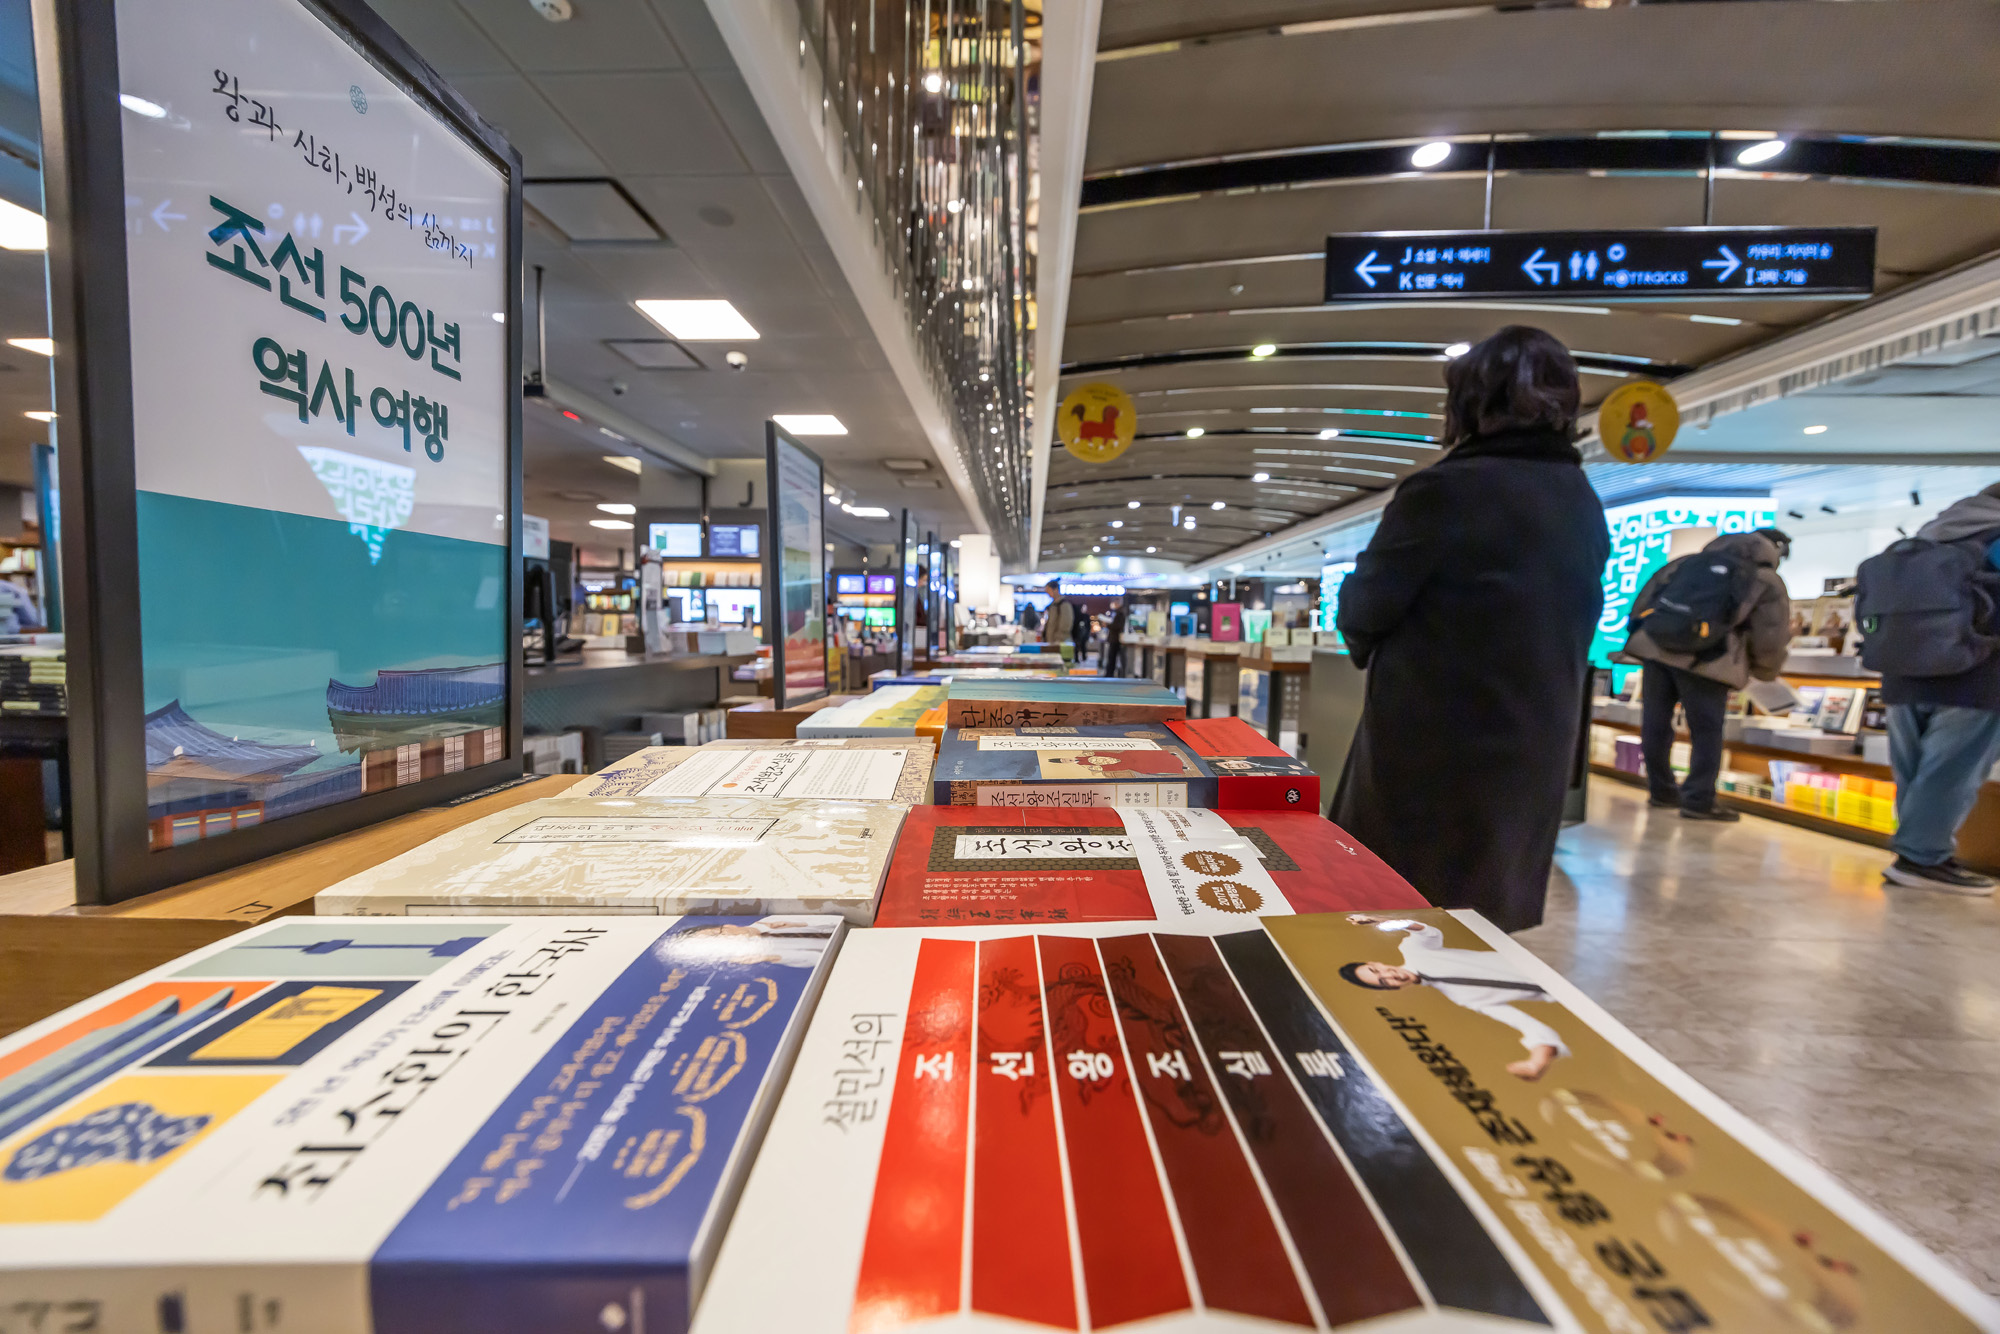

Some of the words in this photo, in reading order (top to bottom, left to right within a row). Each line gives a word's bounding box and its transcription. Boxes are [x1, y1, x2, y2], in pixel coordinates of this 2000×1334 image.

[212, 69, 283, 141] 왕과
[421, 213, 474, 269] 삶까지
[1400, 246, 1413, 265] J
[206, 195, 327, 323] 조선
[339, 265, 462, 381] 500년
[1399, 272, 1414, 291] K
[252, 337, 362, 437] 역사
[370, 385, 449, 463] 여행
[745, 752, 796, 793] 조선왕조실록
[991, 789, 1099, 807] 조선왕조실록
[1175, 896, 1195, 914] 탄탄한
[1210, 886, 1230, 905] 2017년
[258, 1009, 511, 1199] 최소한의
[485, 928, 610, 996] 한국사
[824, 1012, 899, 1135] 설민석의
